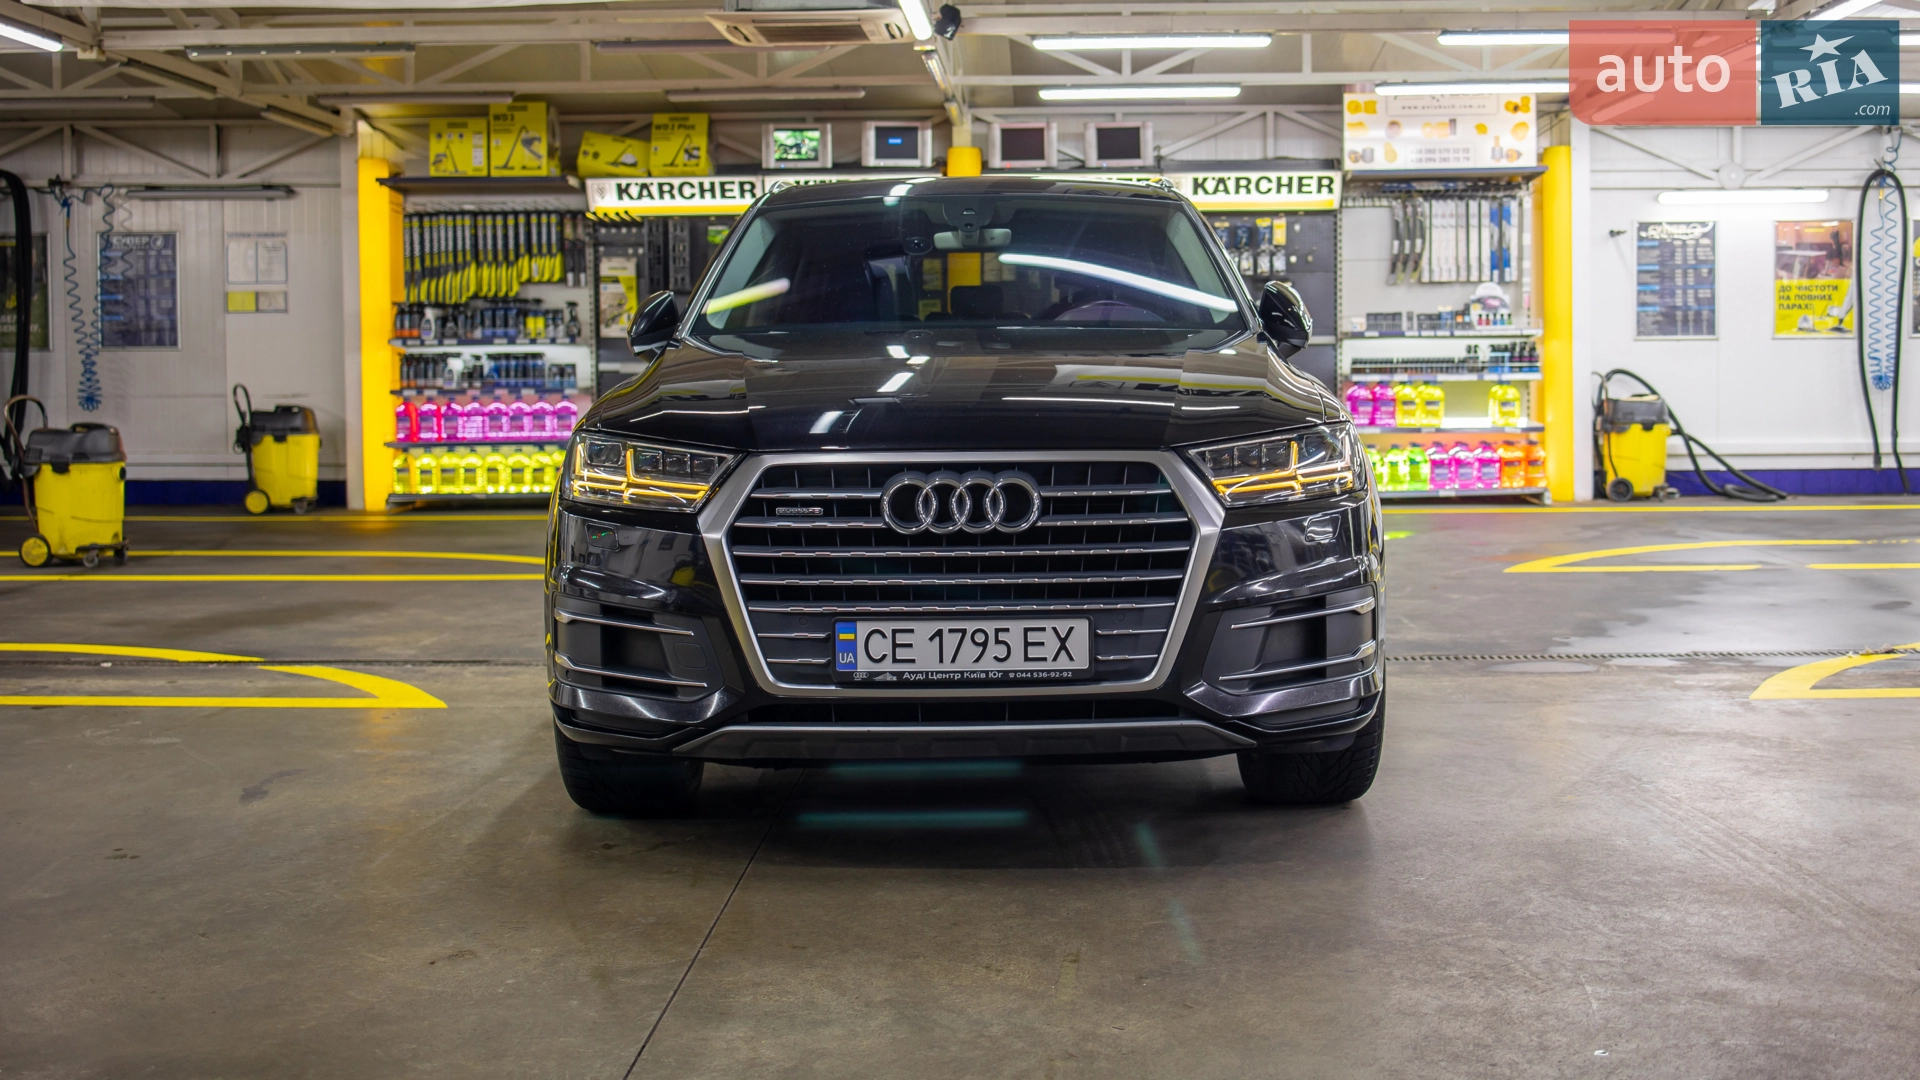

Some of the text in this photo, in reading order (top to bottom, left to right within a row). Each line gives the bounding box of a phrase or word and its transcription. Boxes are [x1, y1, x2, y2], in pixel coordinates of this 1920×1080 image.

[616, 180, 757, 200] KÄRCHER
[1192, 175, 1335, 196] KÄRCHER
[1778, 285, 1792, 293] ДО
[863, 626, 1076, 664] CE 1795 EX
[839, 652, 855, 664] UA
[903, 672, 926, 681] Ауді
[928, 672, 961, 681] Центр
[963, 671, 986, 679] Київ
[988, 671, 1003, 679] Юг
